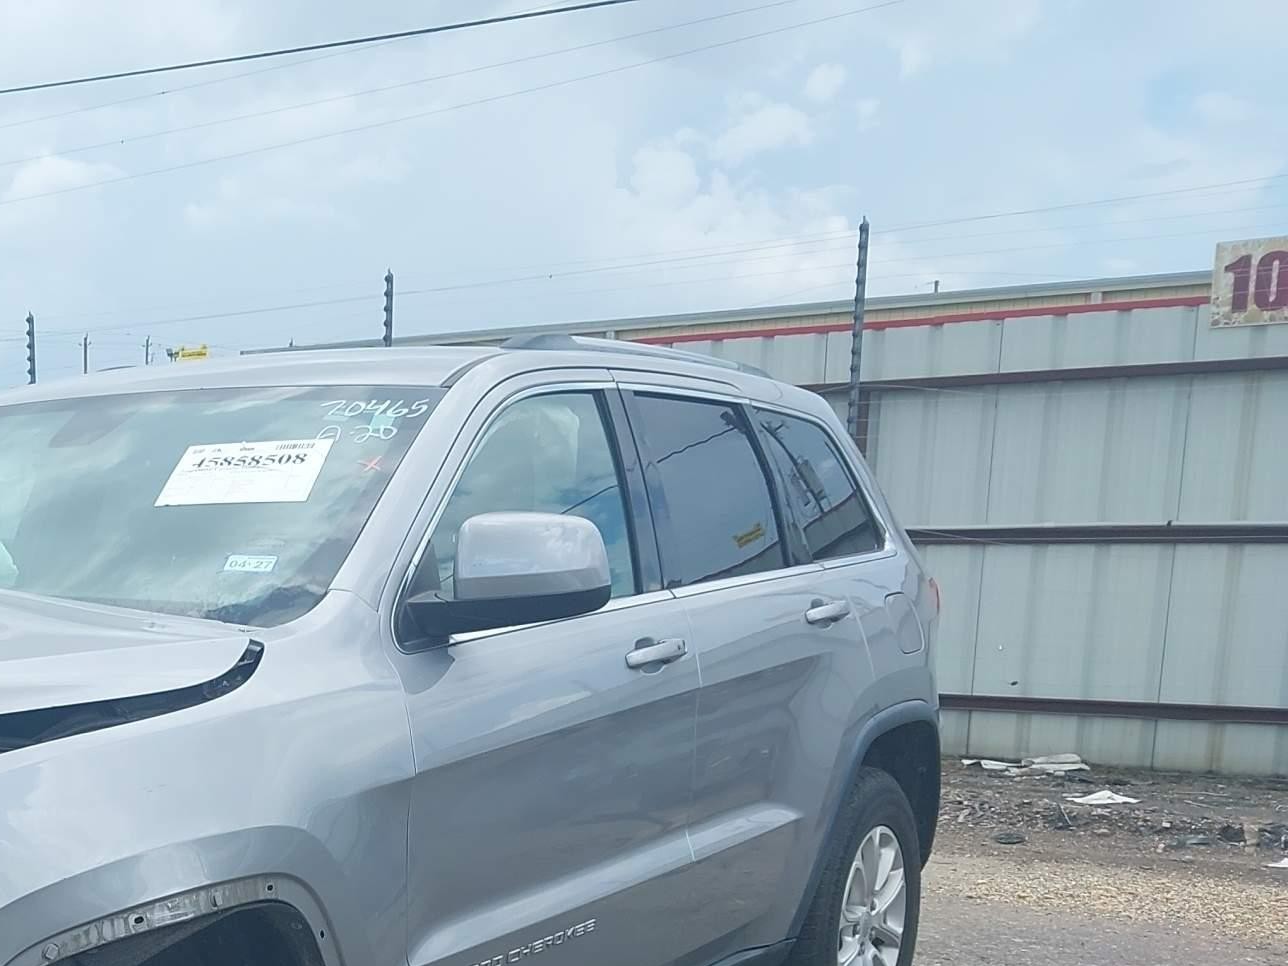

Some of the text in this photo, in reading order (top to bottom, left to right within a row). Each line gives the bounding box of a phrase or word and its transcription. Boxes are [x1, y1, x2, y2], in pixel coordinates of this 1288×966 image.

[1223, 249, 1288, 313] 10
[192, 453, 308, 468] 45858508
[507, 918, 597, 966] CHEROKEE
